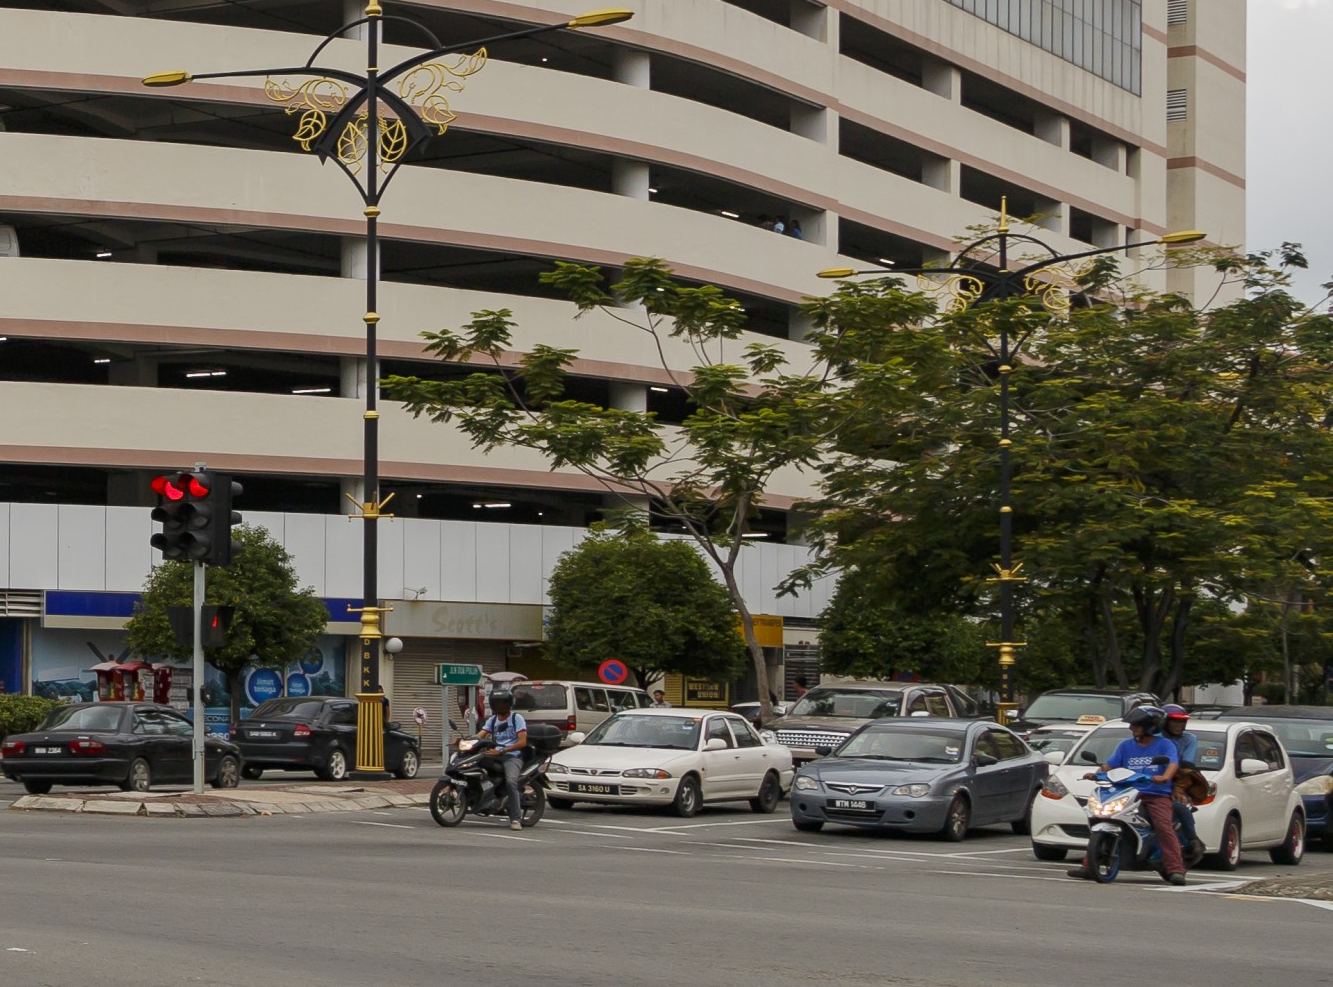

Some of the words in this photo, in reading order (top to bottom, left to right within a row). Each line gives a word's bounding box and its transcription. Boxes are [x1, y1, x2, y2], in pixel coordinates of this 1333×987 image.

[363, 638, 371, 687] DBKK
[578, 784, 587, 792] SA
[604, 785, 611, 793] U
